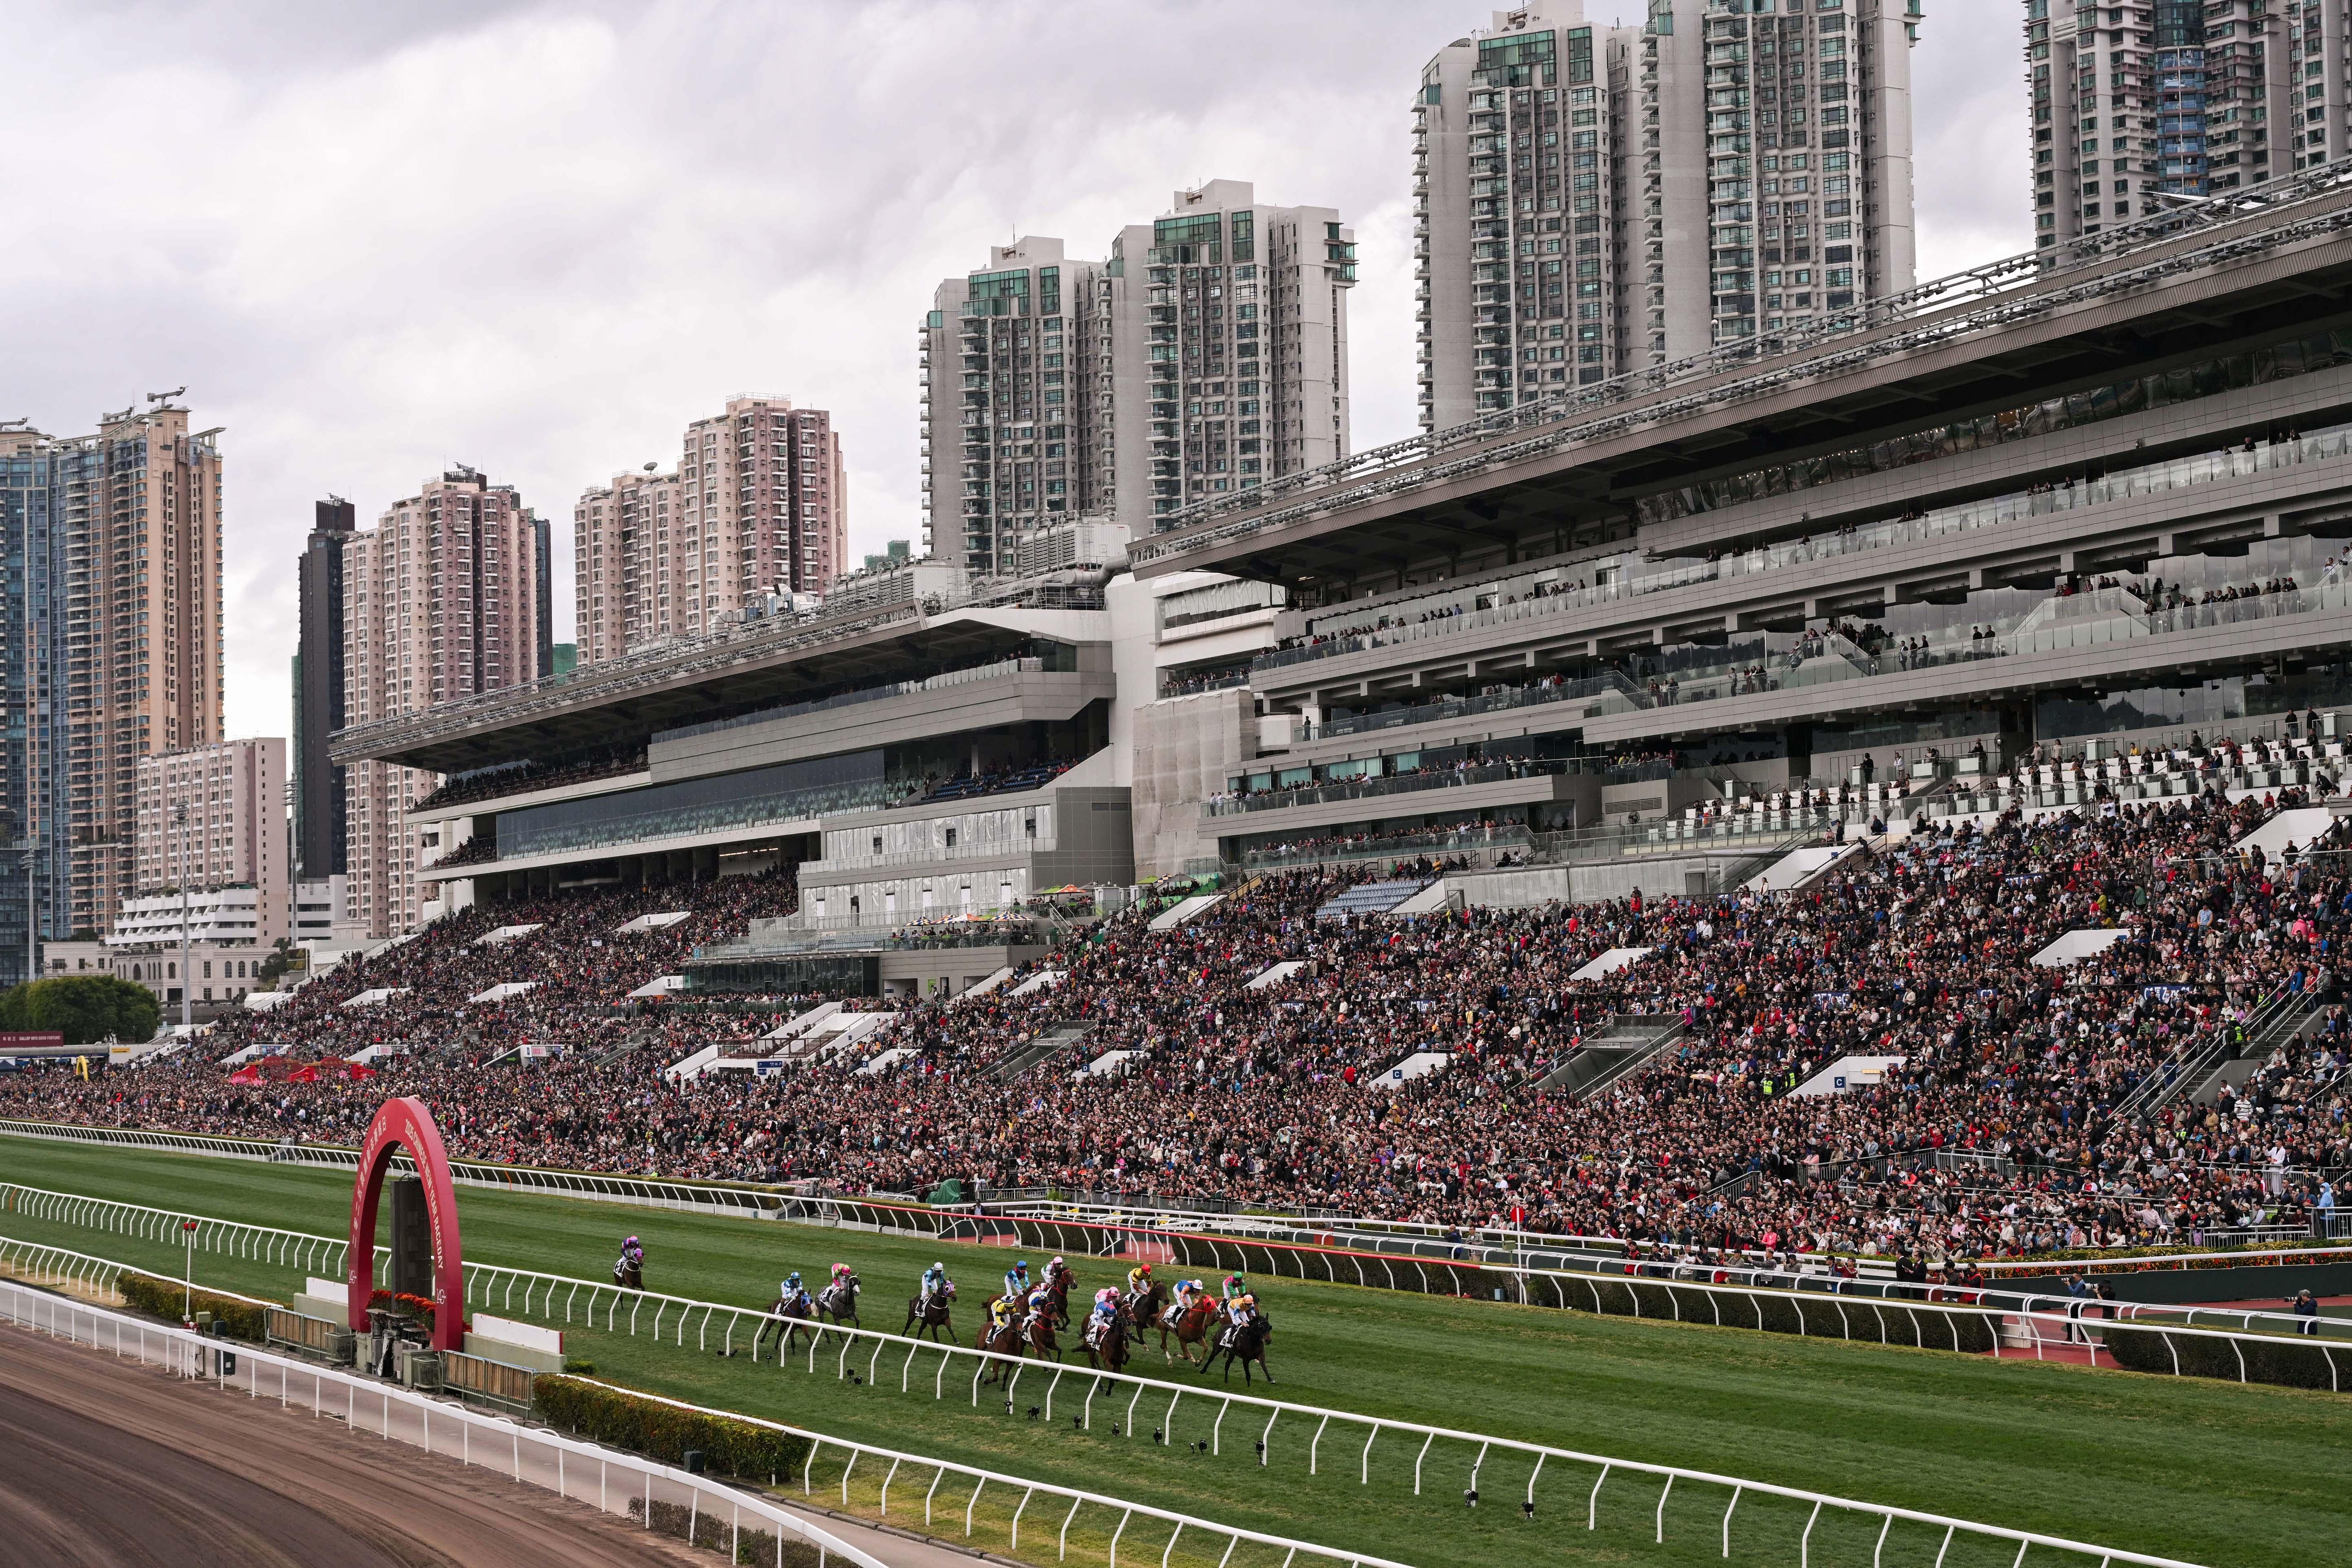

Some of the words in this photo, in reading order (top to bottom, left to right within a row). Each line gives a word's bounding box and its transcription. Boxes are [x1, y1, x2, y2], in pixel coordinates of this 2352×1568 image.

[116, 1093, 122, 1101] 2
[405, 1118, 414, 1140] 2025
[413, 1131, 427, 1169] CHINESE
[434, 1216, 443, 1269] RACEDAY
